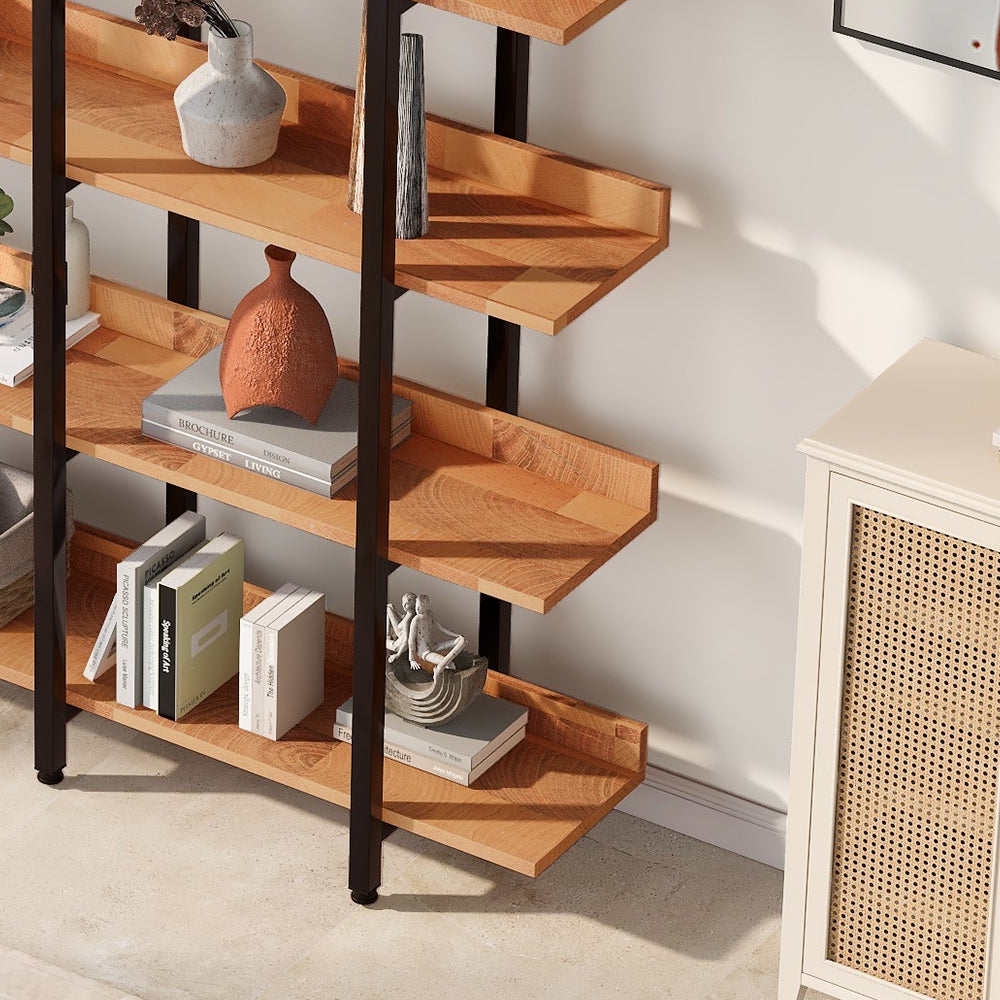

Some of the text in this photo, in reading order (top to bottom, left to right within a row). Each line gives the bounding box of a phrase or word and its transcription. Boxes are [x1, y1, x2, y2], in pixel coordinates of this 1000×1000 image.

[178, 418, 291, 464] BROCHURE DISIGN
[192, 442, 281, 479] GYPSET LIVING
[144, 550, 176, 579] PICASSO
[122, 573, 130, 608] PICASSO
[161, 619, 172, 674] Speaking of Art
[267, 665, 275, 687] Hidden
[266, 687, 274, 699] The
[338, 726, 352, 740] Fre
